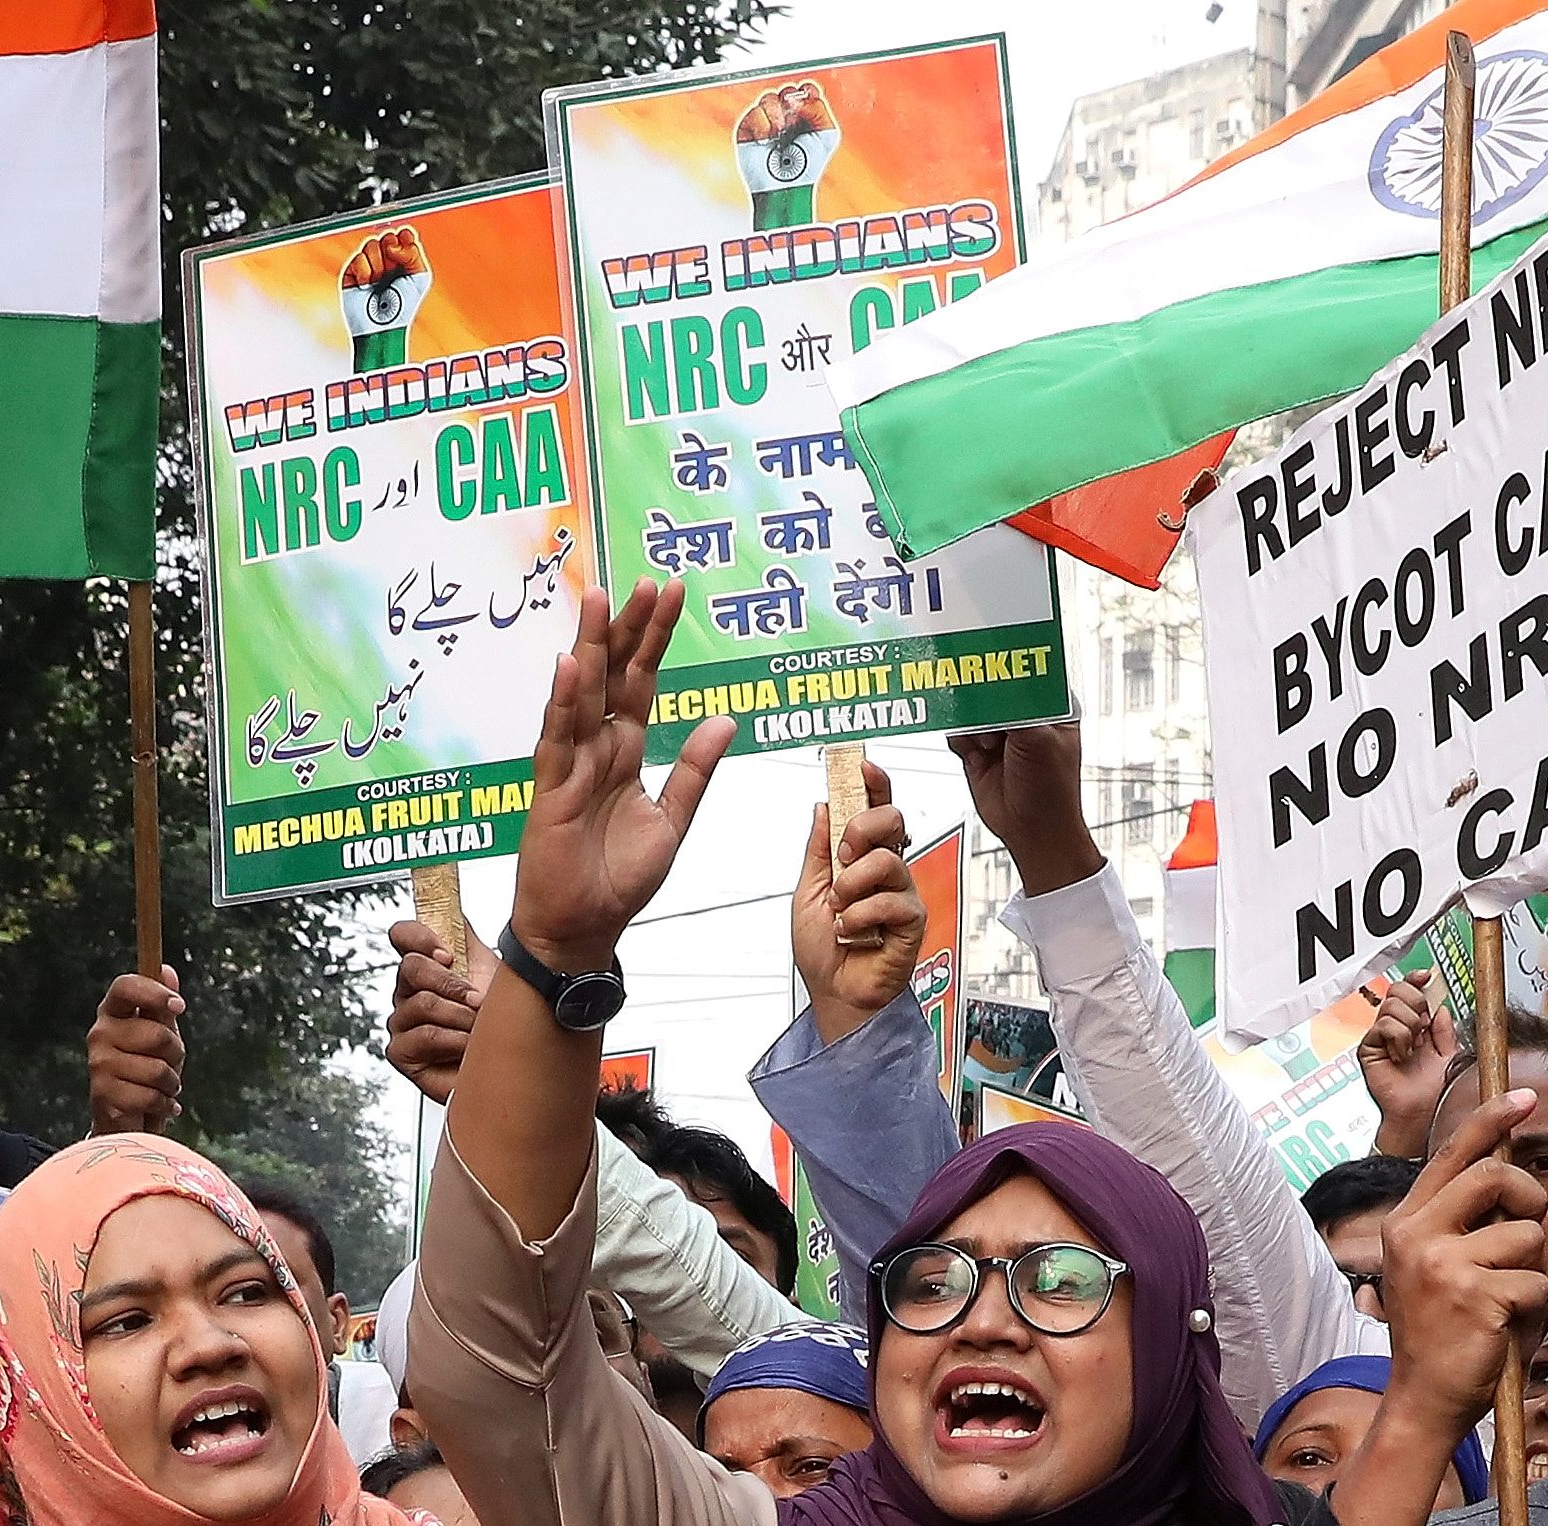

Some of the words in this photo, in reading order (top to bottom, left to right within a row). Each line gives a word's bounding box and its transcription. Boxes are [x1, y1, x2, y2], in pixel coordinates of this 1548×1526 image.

[602, 246, 711, 308] WE
[722, 204, 997, 291] INDIANS
[622, 306, 768, 419] NRC
[781, 323, 832, 372] और
[226, 390, 316, 451] WE
[326, 342, 566, 432] INDIANS
[372, 460, 419, 512] اور
[436, 409, 566, 521] CAA
[674, 433, 727, 492] के
[1237, 319, 1471, 575] REJECT
[241, 446, 361, 560] NRC
[647, 513, 733, 572] देश
[761, 492, 831, 555] को
[489, 529, 574, 628] نہیں
[712, 569, 805, 637] नही
[1273, 510, 1470, 734] BYCOT
[648, 682, 782, 724] ECHUA
[787, 671, 889, 707] FRUIT
[902, 646, 1051, 692] MARKET
[770, 646, 888, 672] COURTESY
[344, 659, 425, 757] نہیں
[754, 698, 926, 744] (KOLKATA)
[357, 772, 458, 801] COURTESY
[1269, 708, 1395, 848] NO
[234, 808, 365, 855] MECHUA
[372, 791, 463, 832] FRUIT
[342, 822, 493, 869] (KOLKATA)
[1295, 848, 1421, 983] NO
